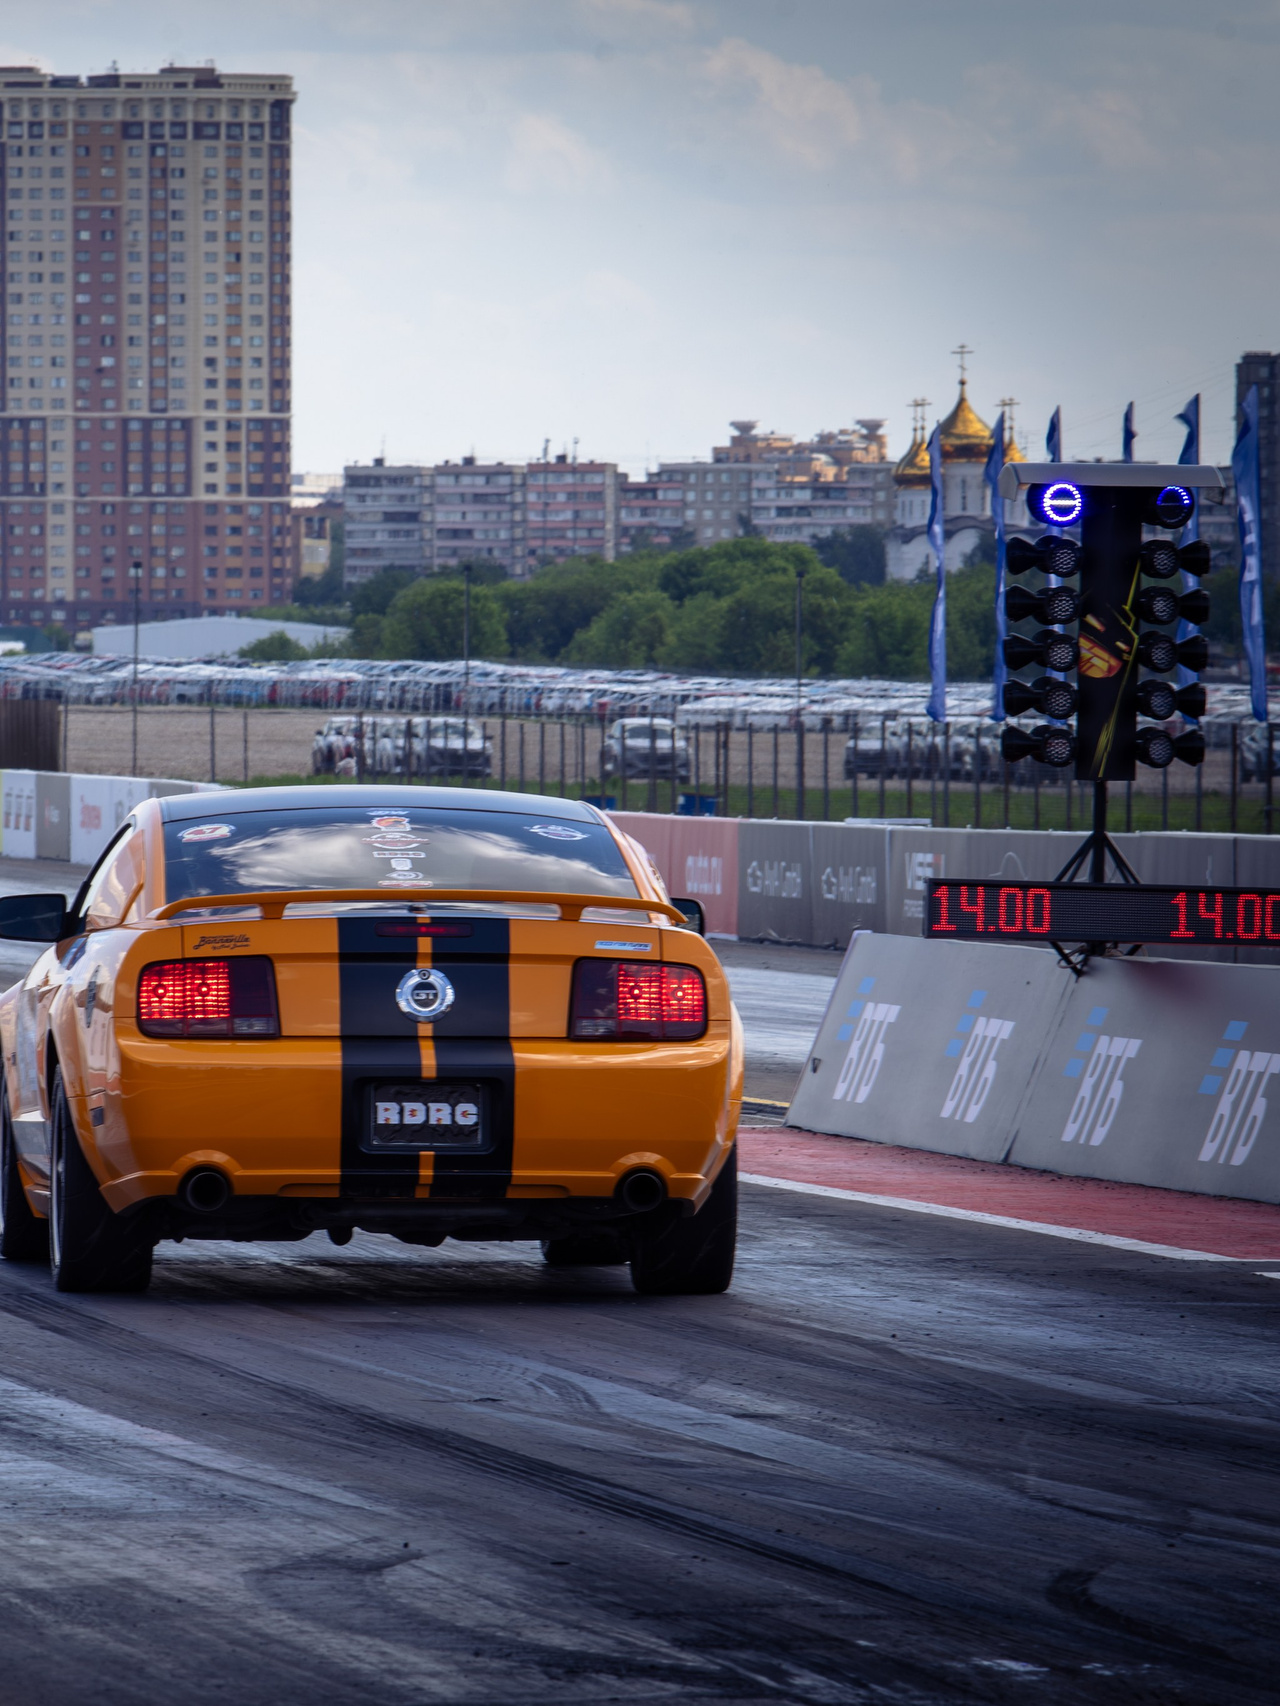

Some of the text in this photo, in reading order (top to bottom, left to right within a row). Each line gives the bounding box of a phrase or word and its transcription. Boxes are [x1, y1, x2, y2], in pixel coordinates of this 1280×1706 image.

[932, 886, 1051, 933] 14.00
[1170, 892, 1280, 939] 14.00
[413, 989, 438, 1000] GT
[832, 1002, 902, 1104] ВТБ
[939, 1016, 1016, 1123] ВТБ
[375, 1102, 478, 1125] RDRC
[1061, 1035, 1143, 1146] ВТБ
[1197, 1050, 1280, 1166] ВТБ
